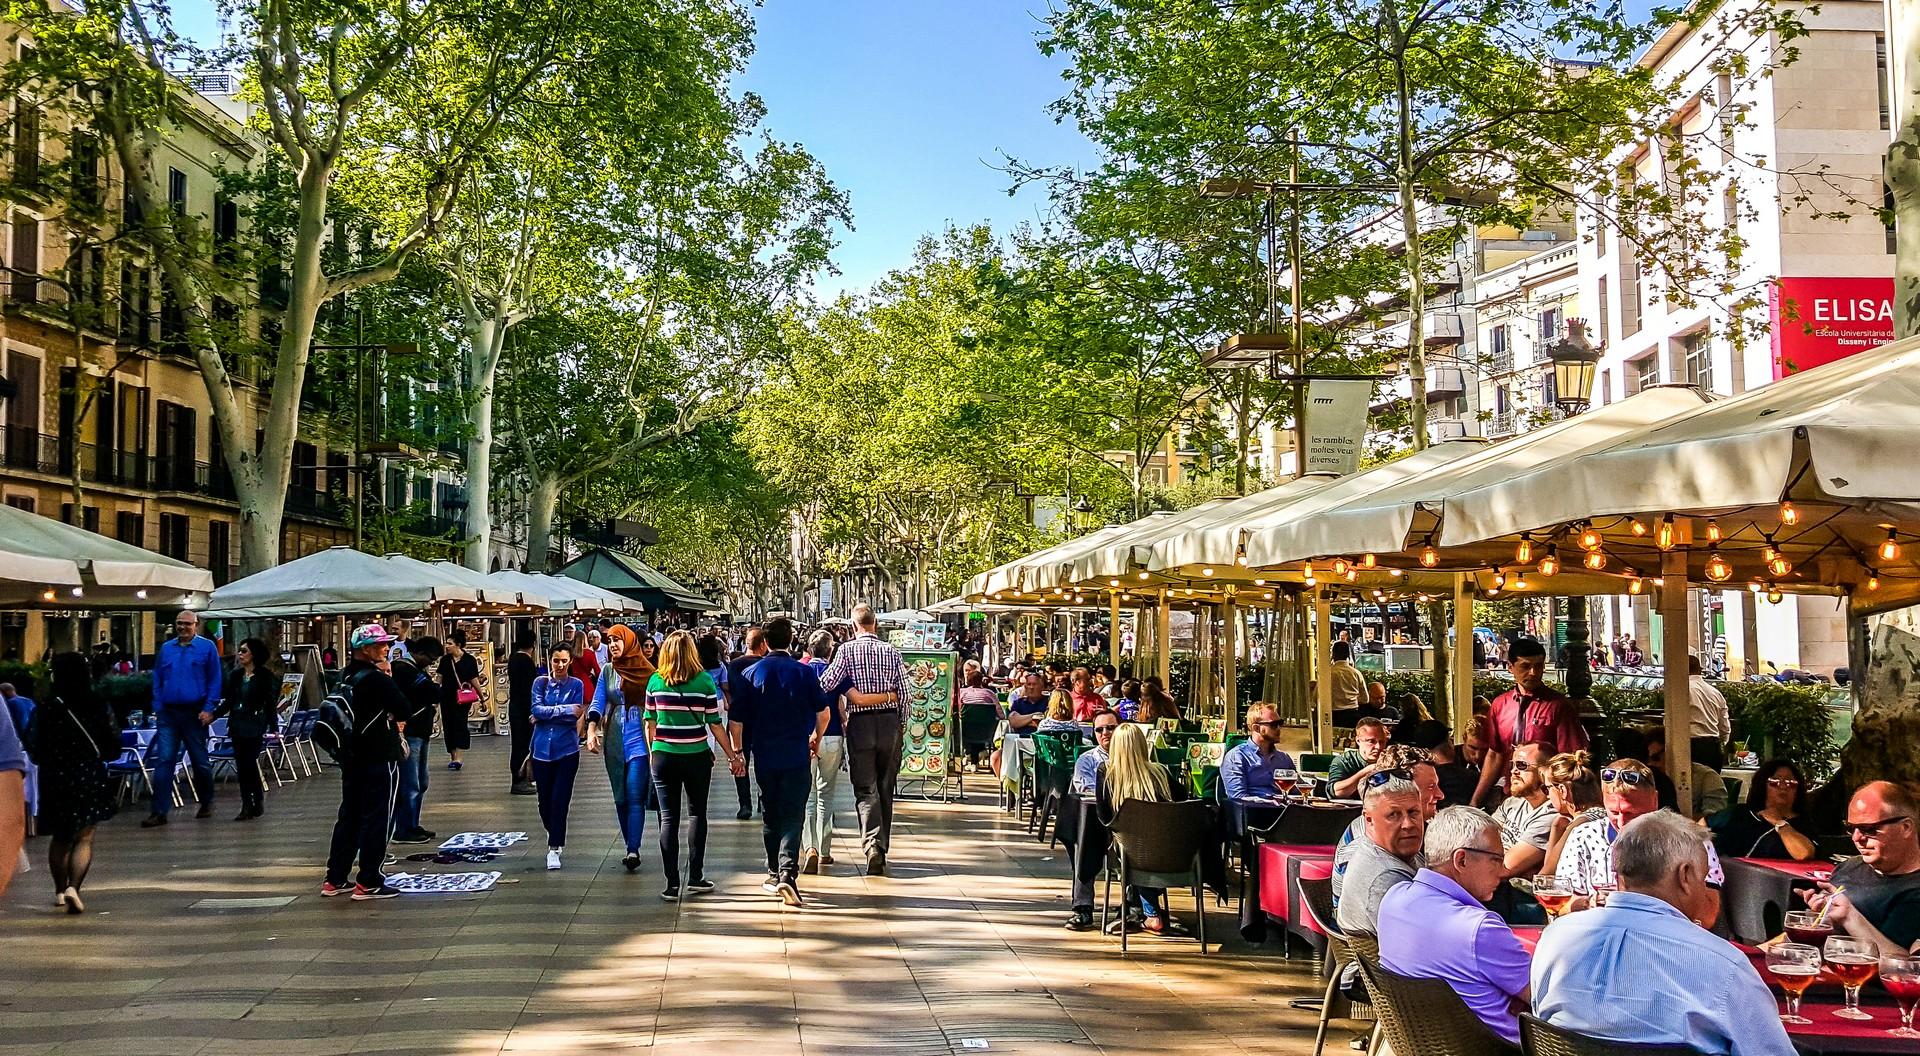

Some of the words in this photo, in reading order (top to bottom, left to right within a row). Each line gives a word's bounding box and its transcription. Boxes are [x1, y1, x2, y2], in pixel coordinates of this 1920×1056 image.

[1814, 299, 1893, 321] ELISA
[1815, 329, 1839, 337] Escola
[1838, 338, 1867, 346] Disseny
[1311, 435, 1322, 444] les
[1310, 446, 1335, 454] moltes
[1309, 455, 1340, 464] diverses
